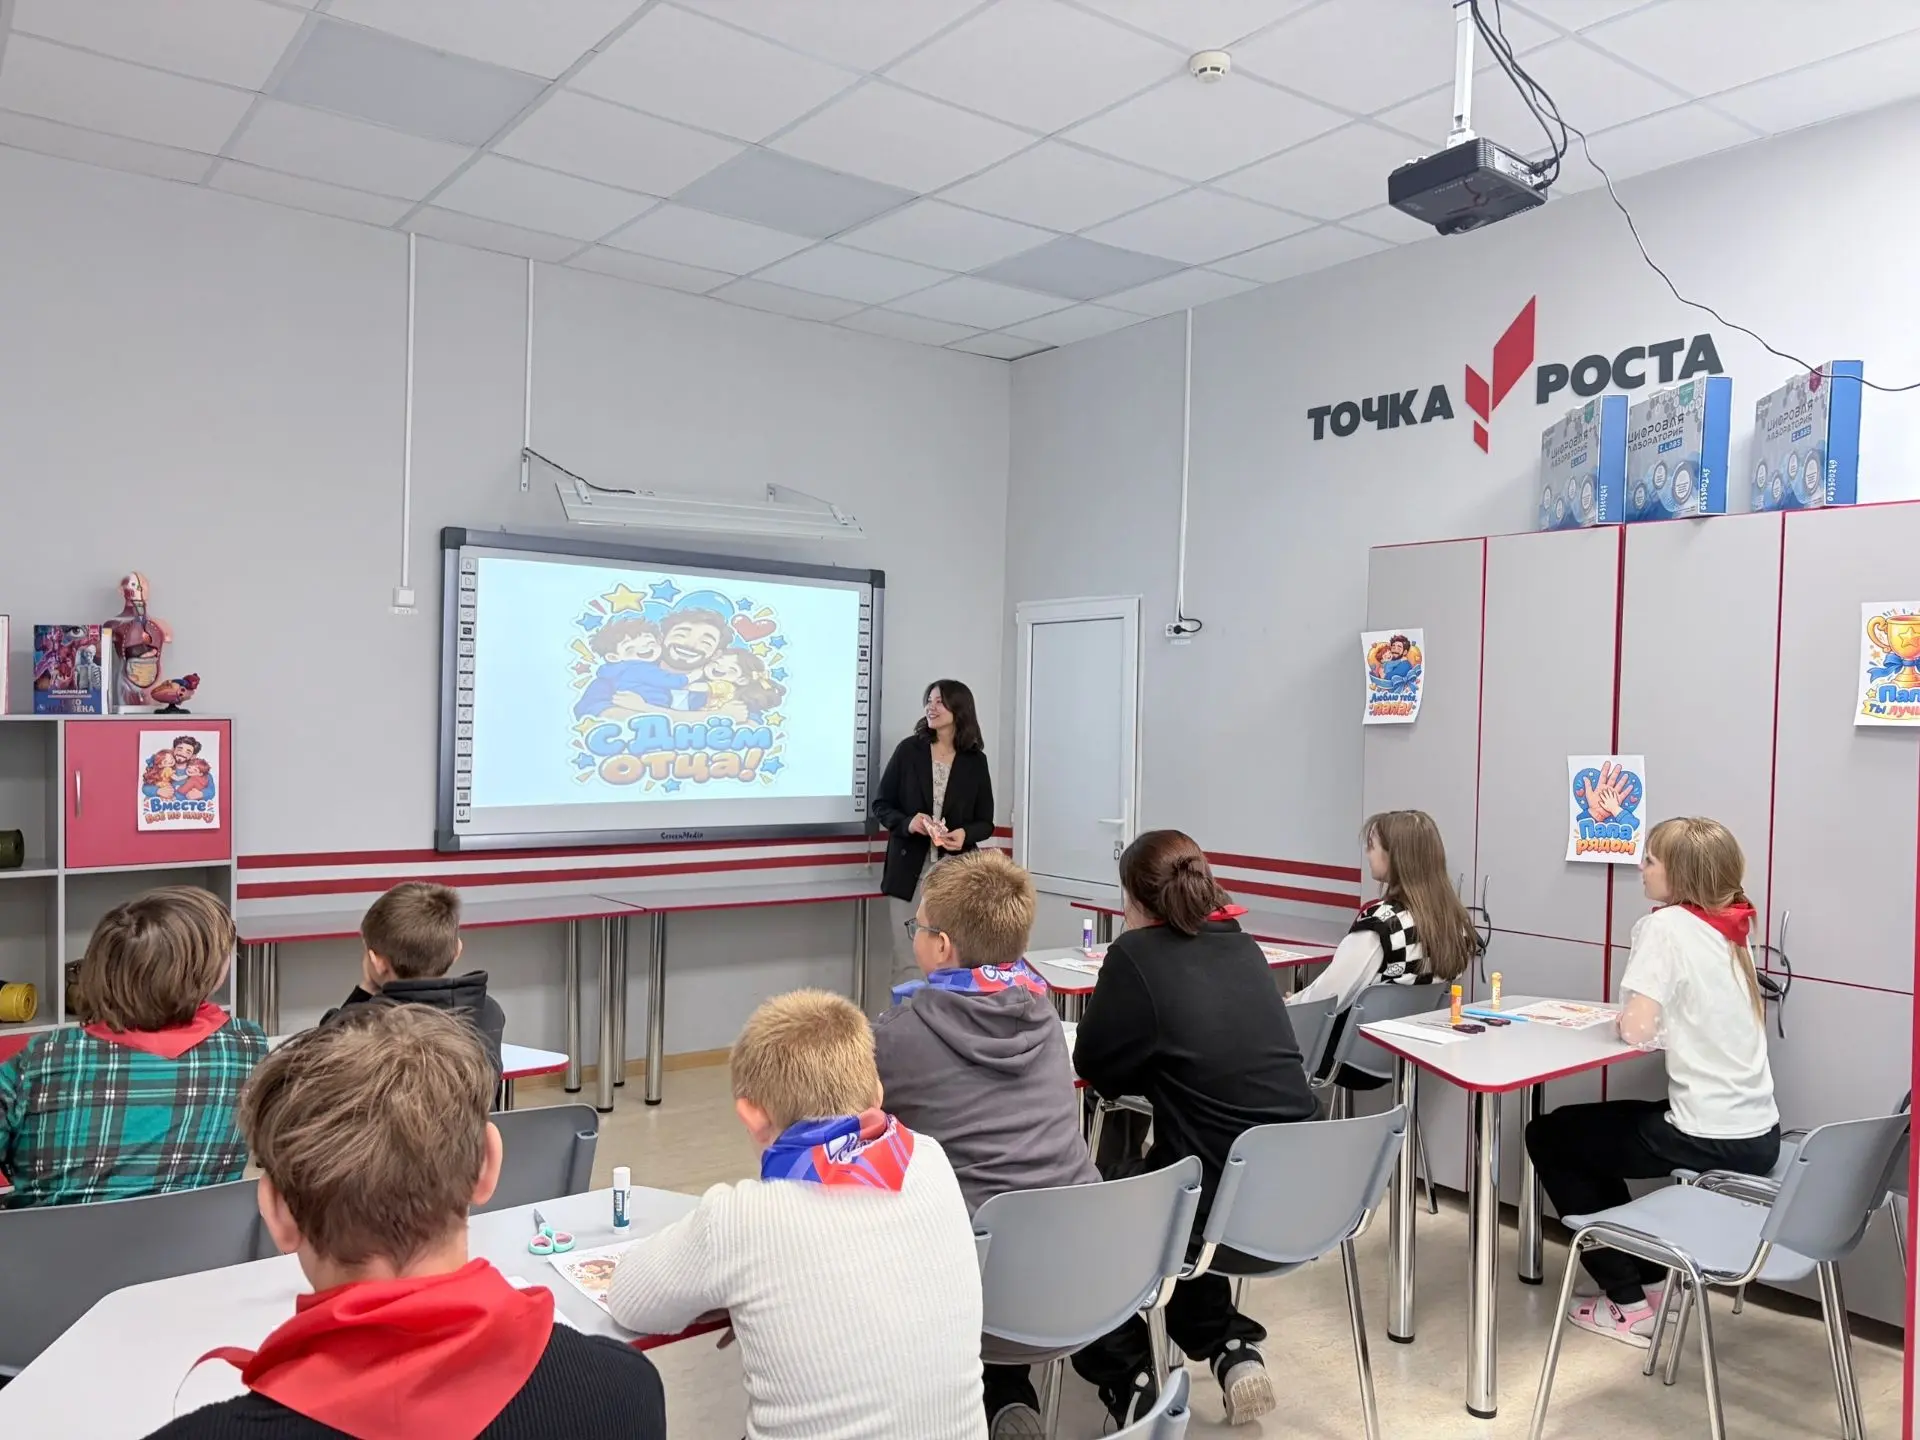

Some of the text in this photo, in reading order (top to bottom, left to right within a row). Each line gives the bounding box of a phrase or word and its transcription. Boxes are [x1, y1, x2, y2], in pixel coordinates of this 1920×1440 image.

[1307, 333, 1724, 440] ТОЧКА РОСТА
[628, 714, 773, 752] Днём
[150, 798, 206, 813] Вместе
[1579, 819, 1633, 841] Папа
[1576, 839, 1636, 856] рядом
